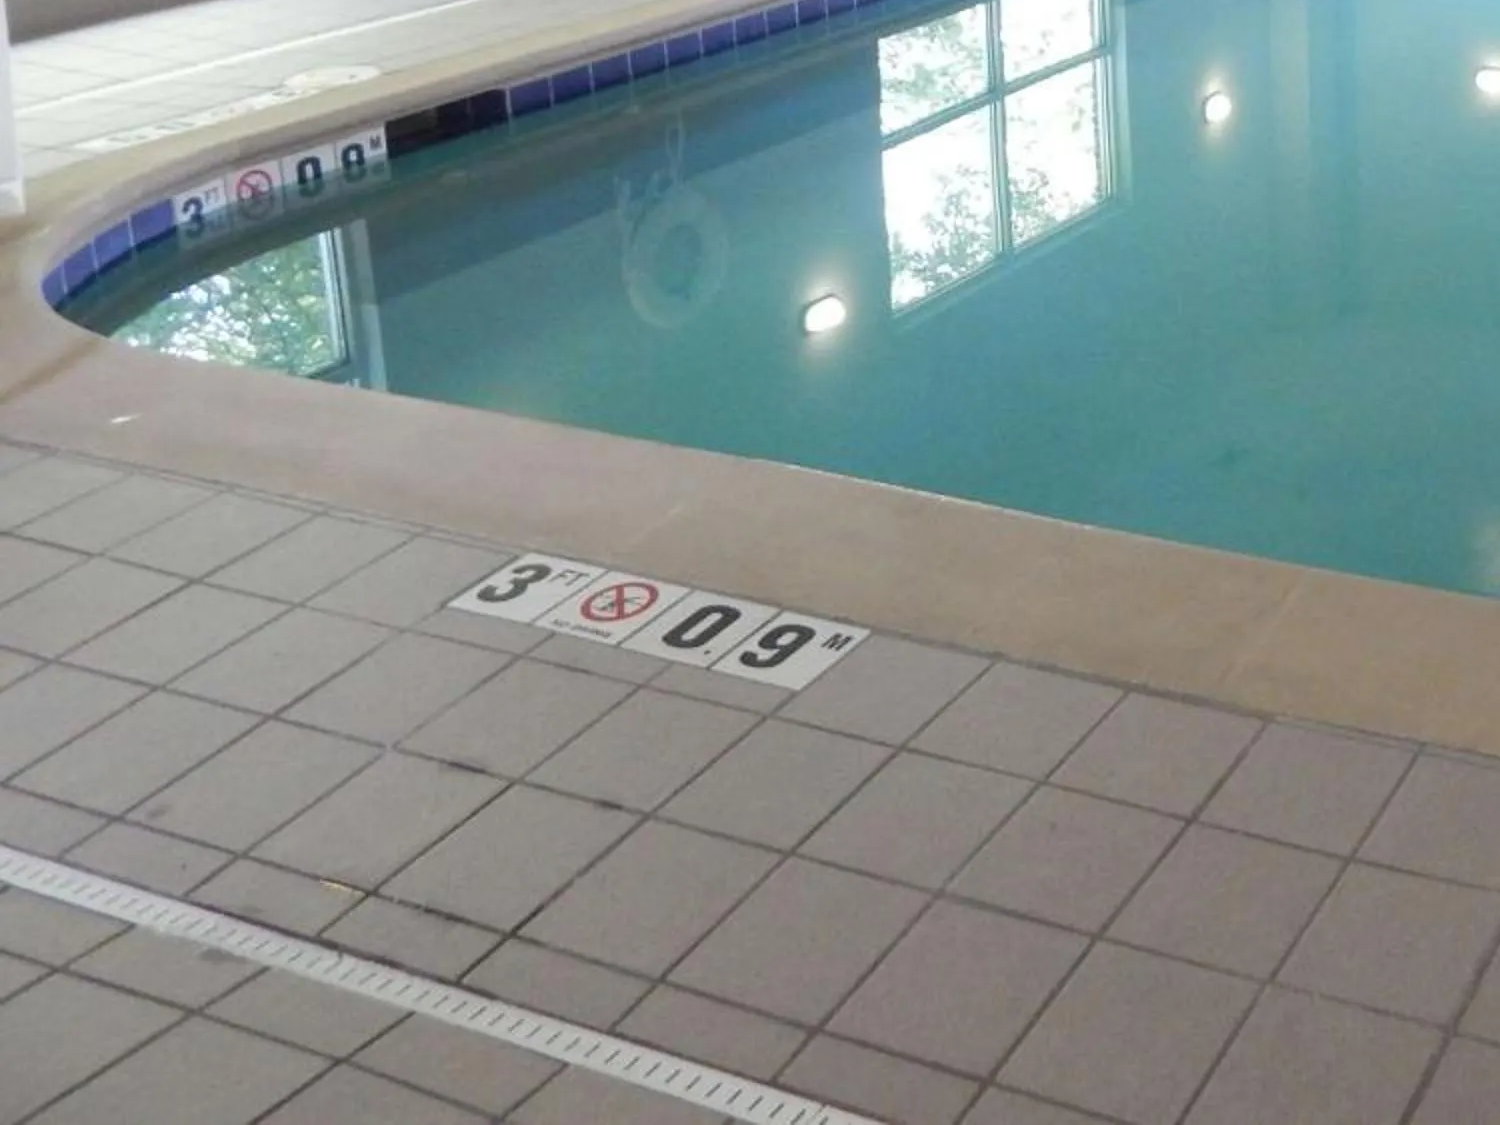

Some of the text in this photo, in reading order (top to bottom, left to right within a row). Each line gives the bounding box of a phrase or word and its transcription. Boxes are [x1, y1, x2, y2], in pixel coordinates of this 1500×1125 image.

[477, 564, 552, 603] 3
[547, 569, 592, 586] FT
[821, 632, 854, 652] M
